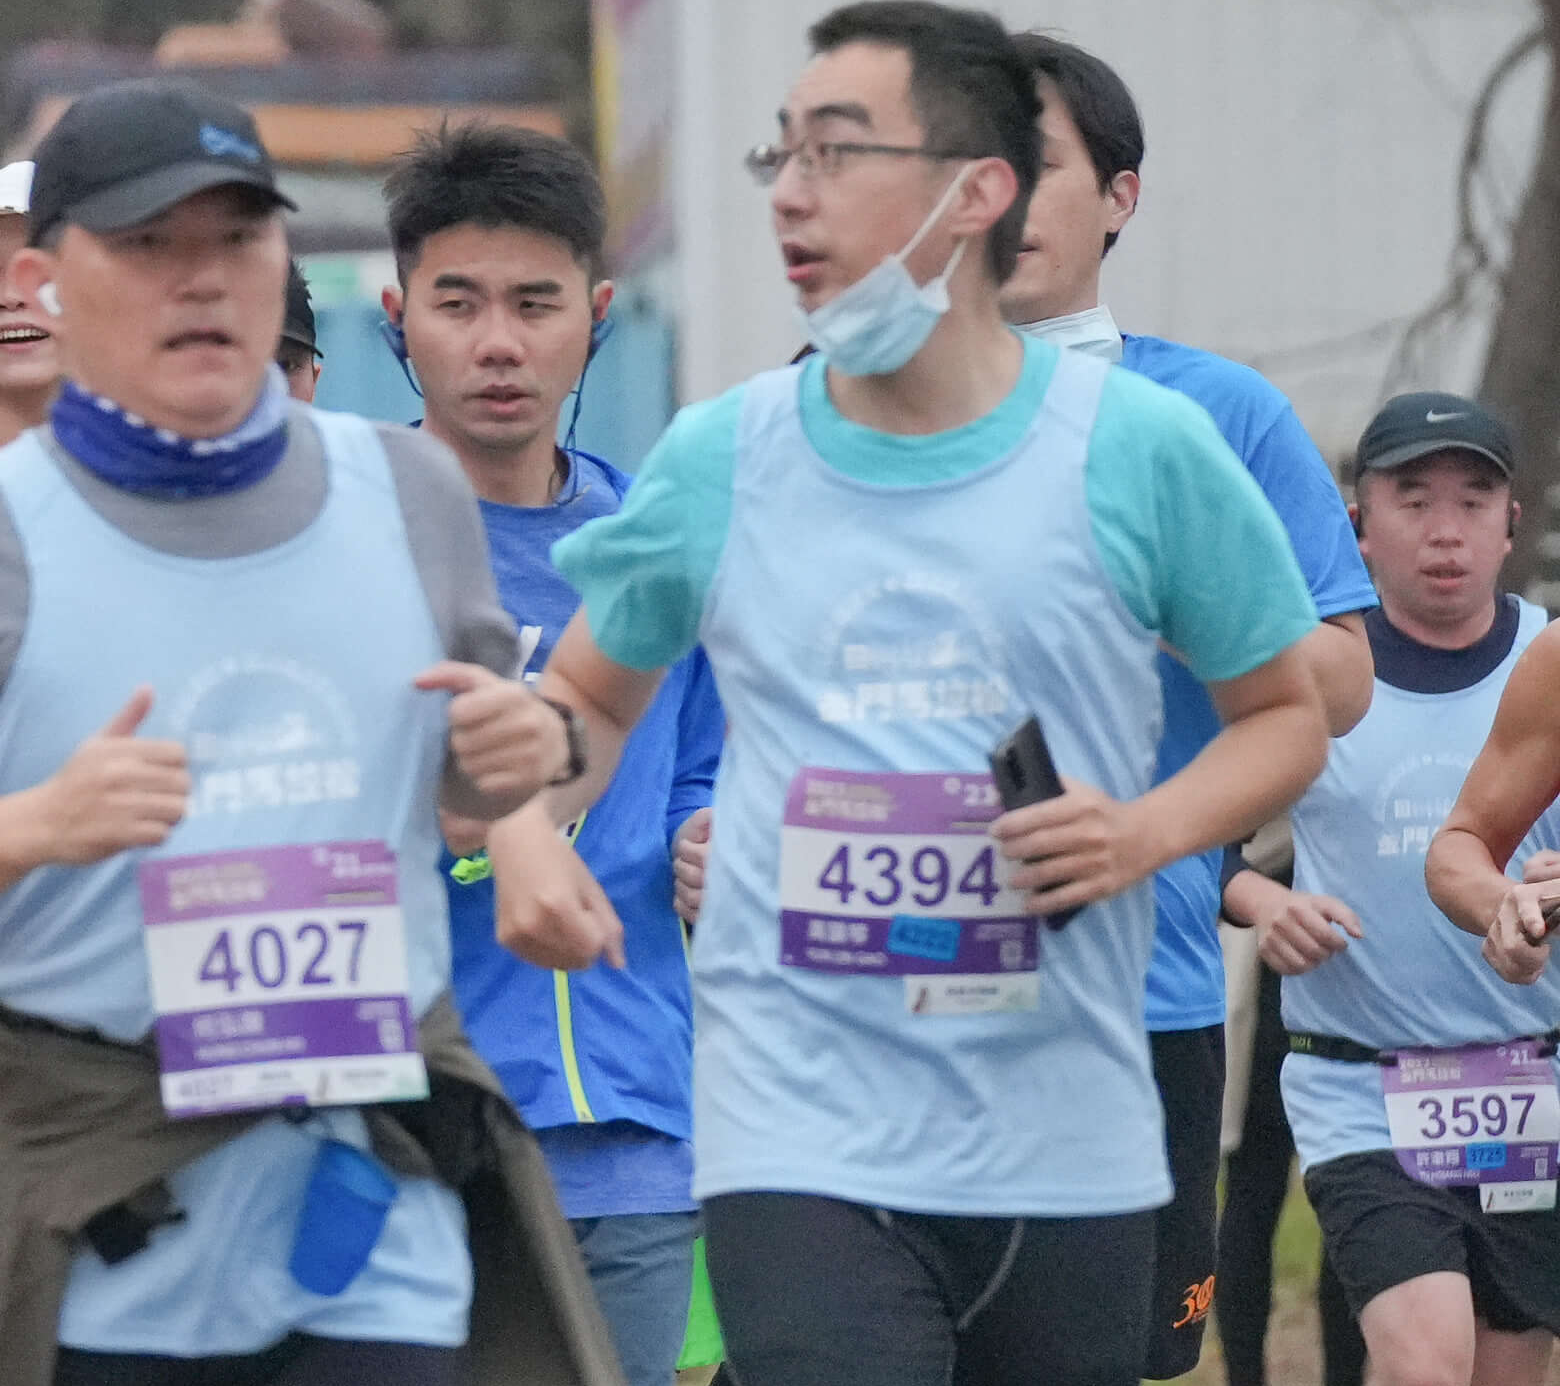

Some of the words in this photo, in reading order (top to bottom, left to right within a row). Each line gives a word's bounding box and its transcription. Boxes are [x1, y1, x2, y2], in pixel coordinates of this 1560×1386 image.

[817, 843, 1000, 907] 4394
[199, 921, 368, 992] 4027
[1418, 1093, 1536, 1139] 3597
